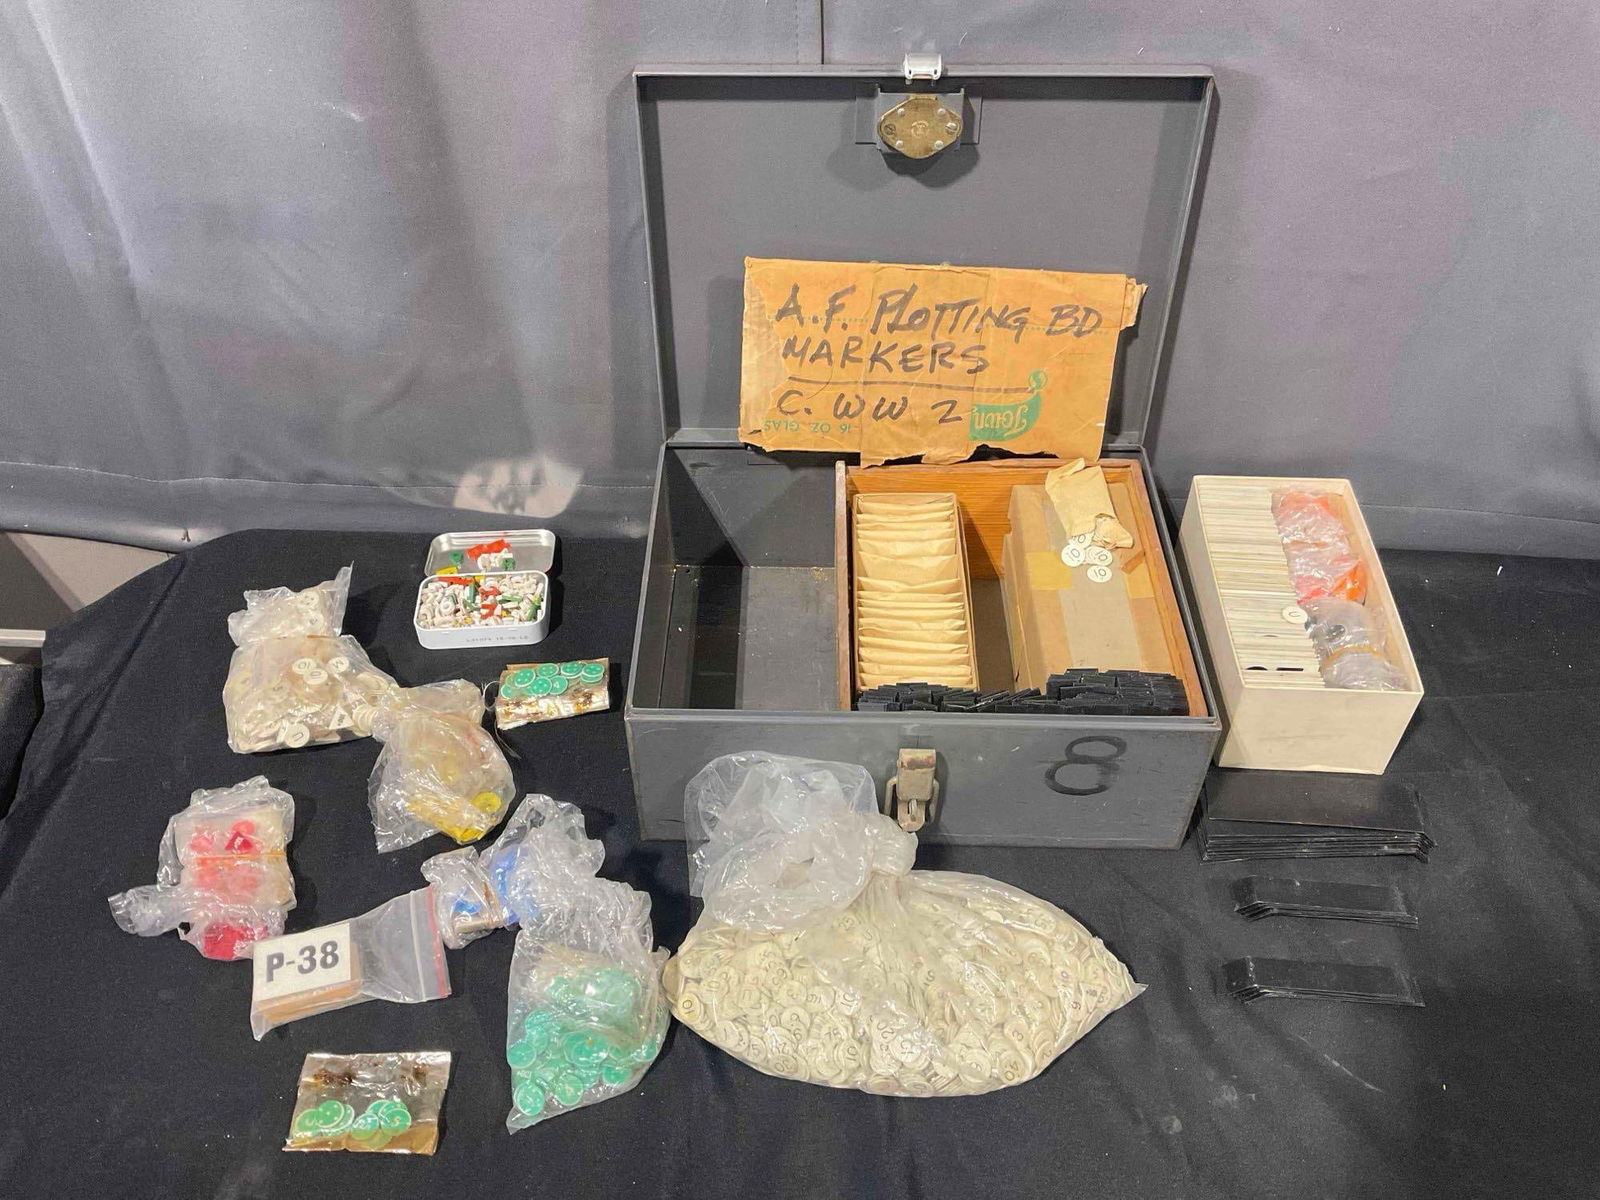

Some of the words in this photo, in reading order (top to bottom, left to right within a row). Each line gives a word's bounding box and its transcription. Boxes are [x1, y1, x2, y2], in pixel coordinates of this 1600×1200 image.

[870, 283, 1032, 344] PLOTTING
[1045, 304, 1103, 338] BD
[782, 335, 990, 375] MARKERS
[931, 399, 963, 424] 2
[1045, 735, 1127, 796] 8
[266, 940, 340, 983] P-38
